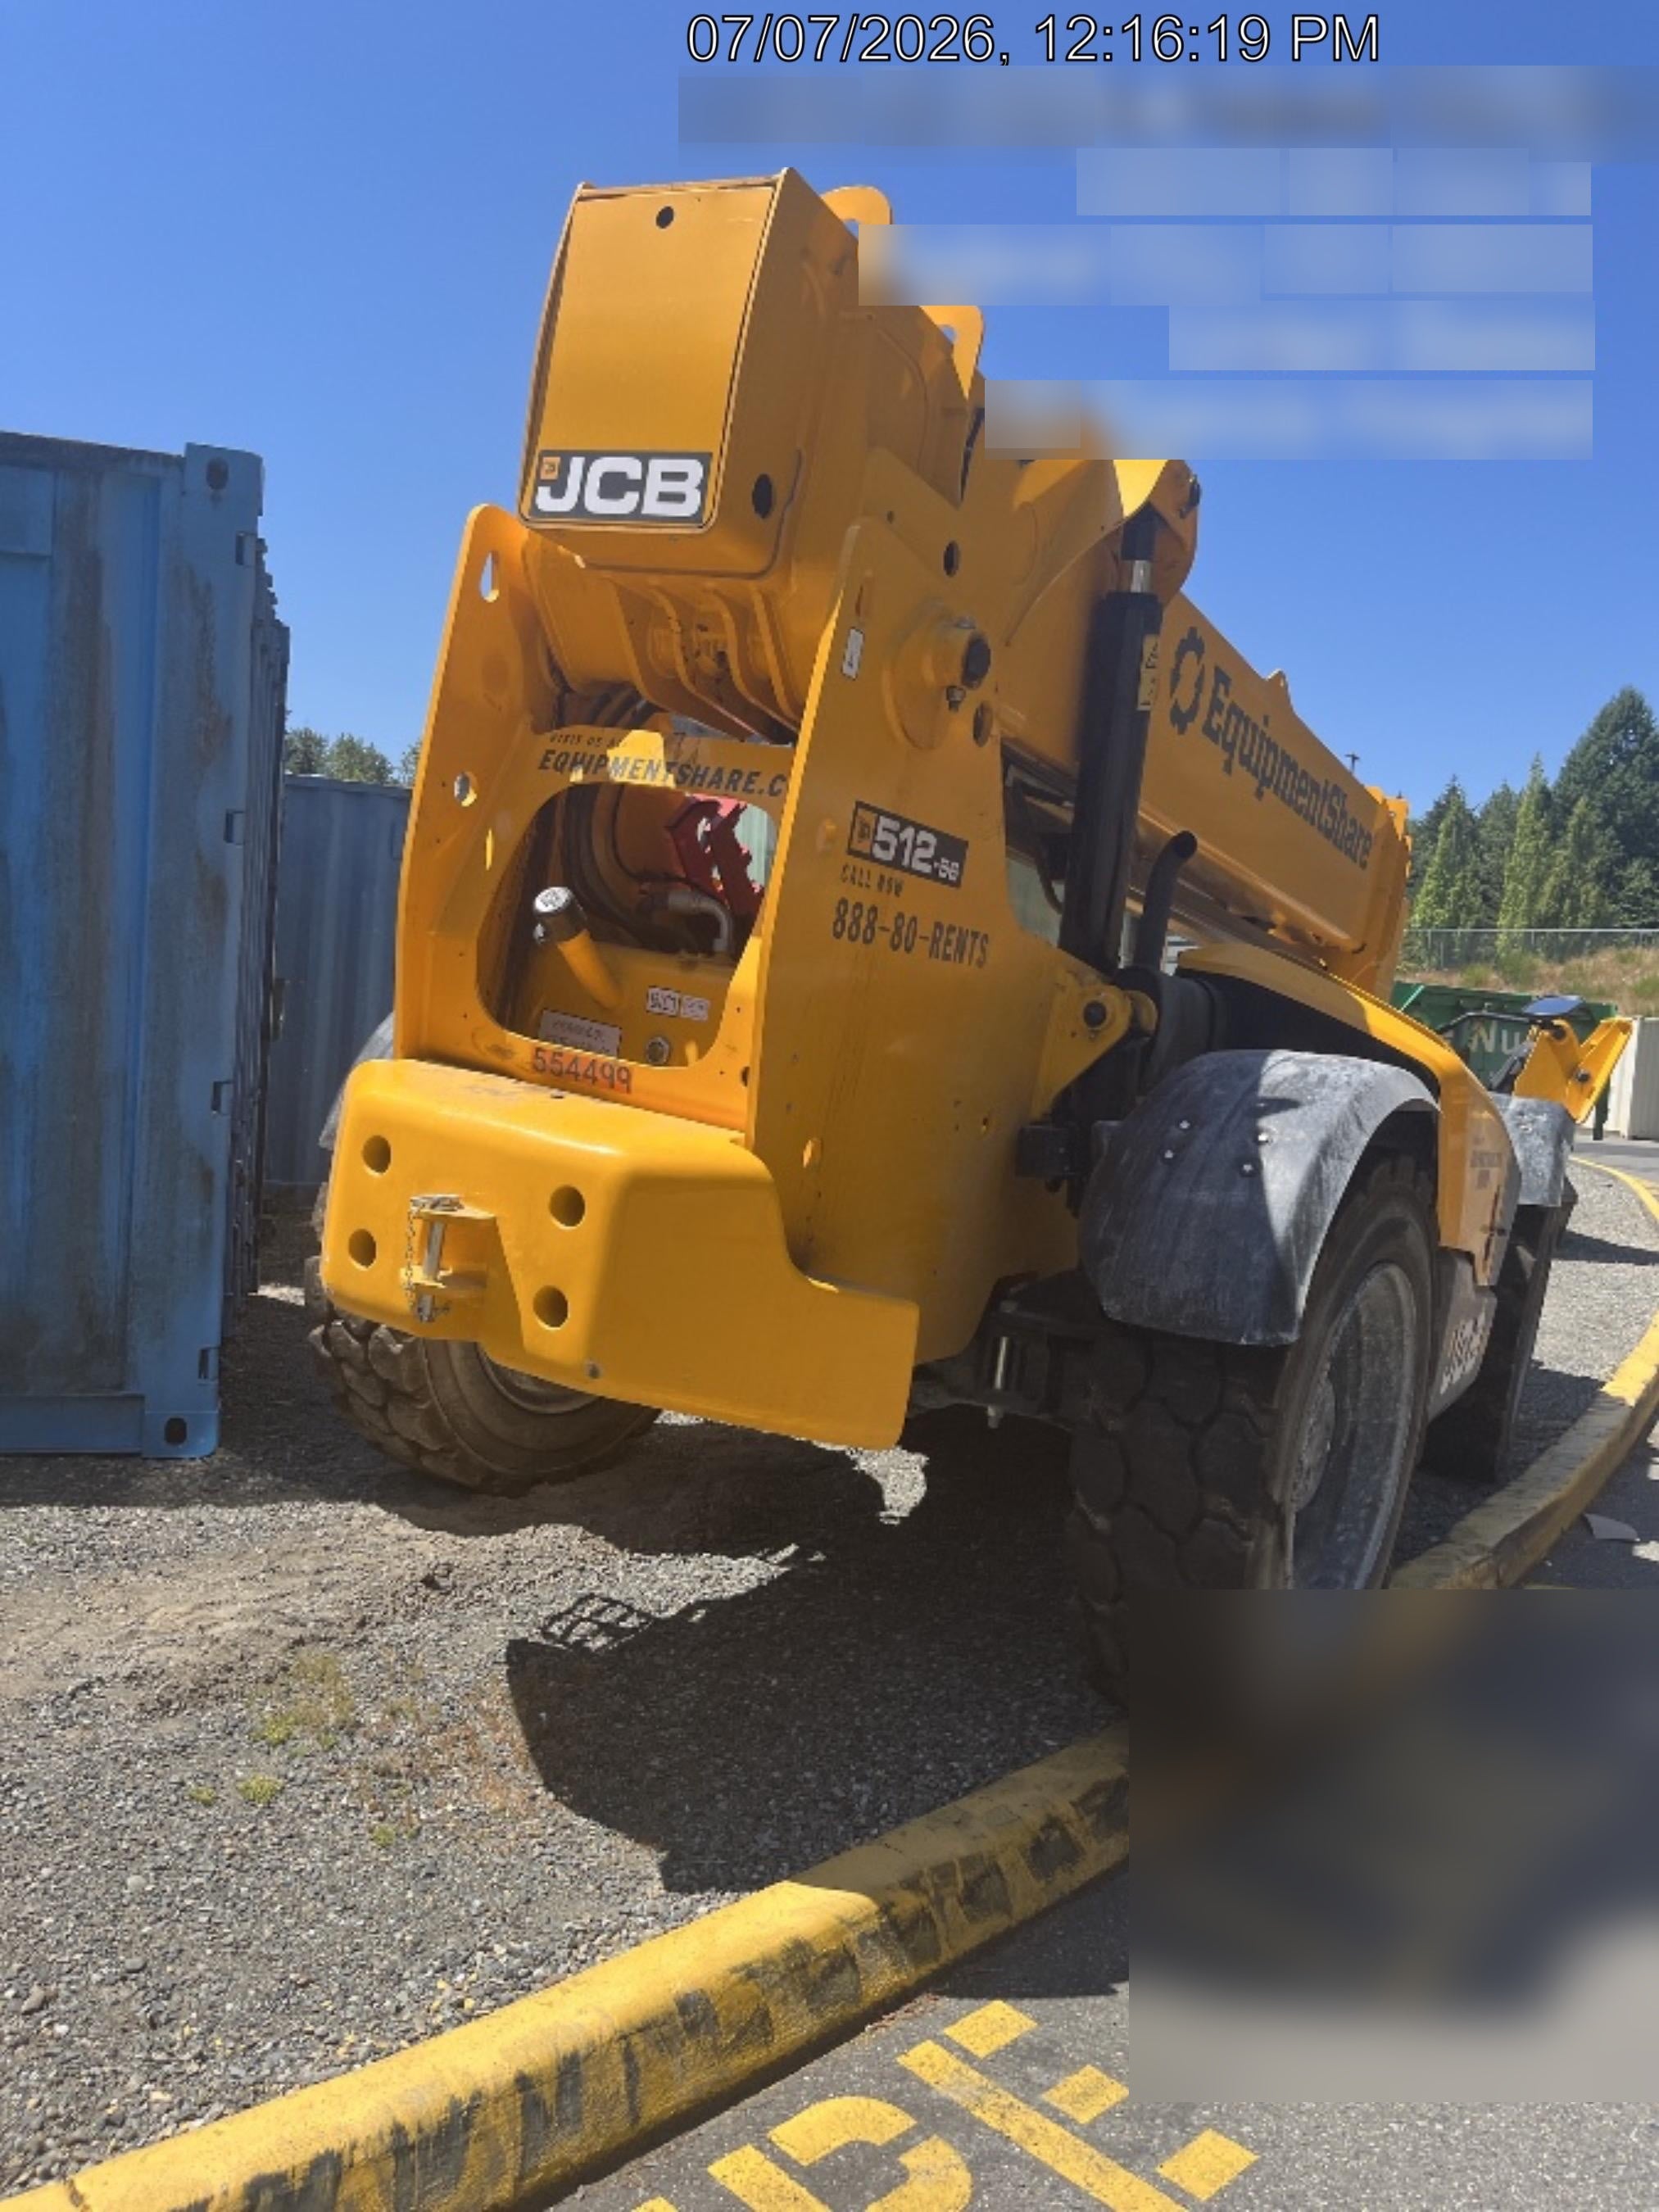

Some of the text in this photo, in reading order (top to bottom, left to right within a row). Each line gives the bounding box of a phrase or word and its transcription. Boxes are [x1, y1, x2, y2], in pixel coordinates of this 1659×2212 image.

[535, 456, 704, 517] JCB
[1202, 665, 1373, 870] EquipmentShare
[840, 863, 872, 889] CALL
[832, 897, 989, 968] 888-80-RENTS
[534, 1047, 632, 1094] 554499
